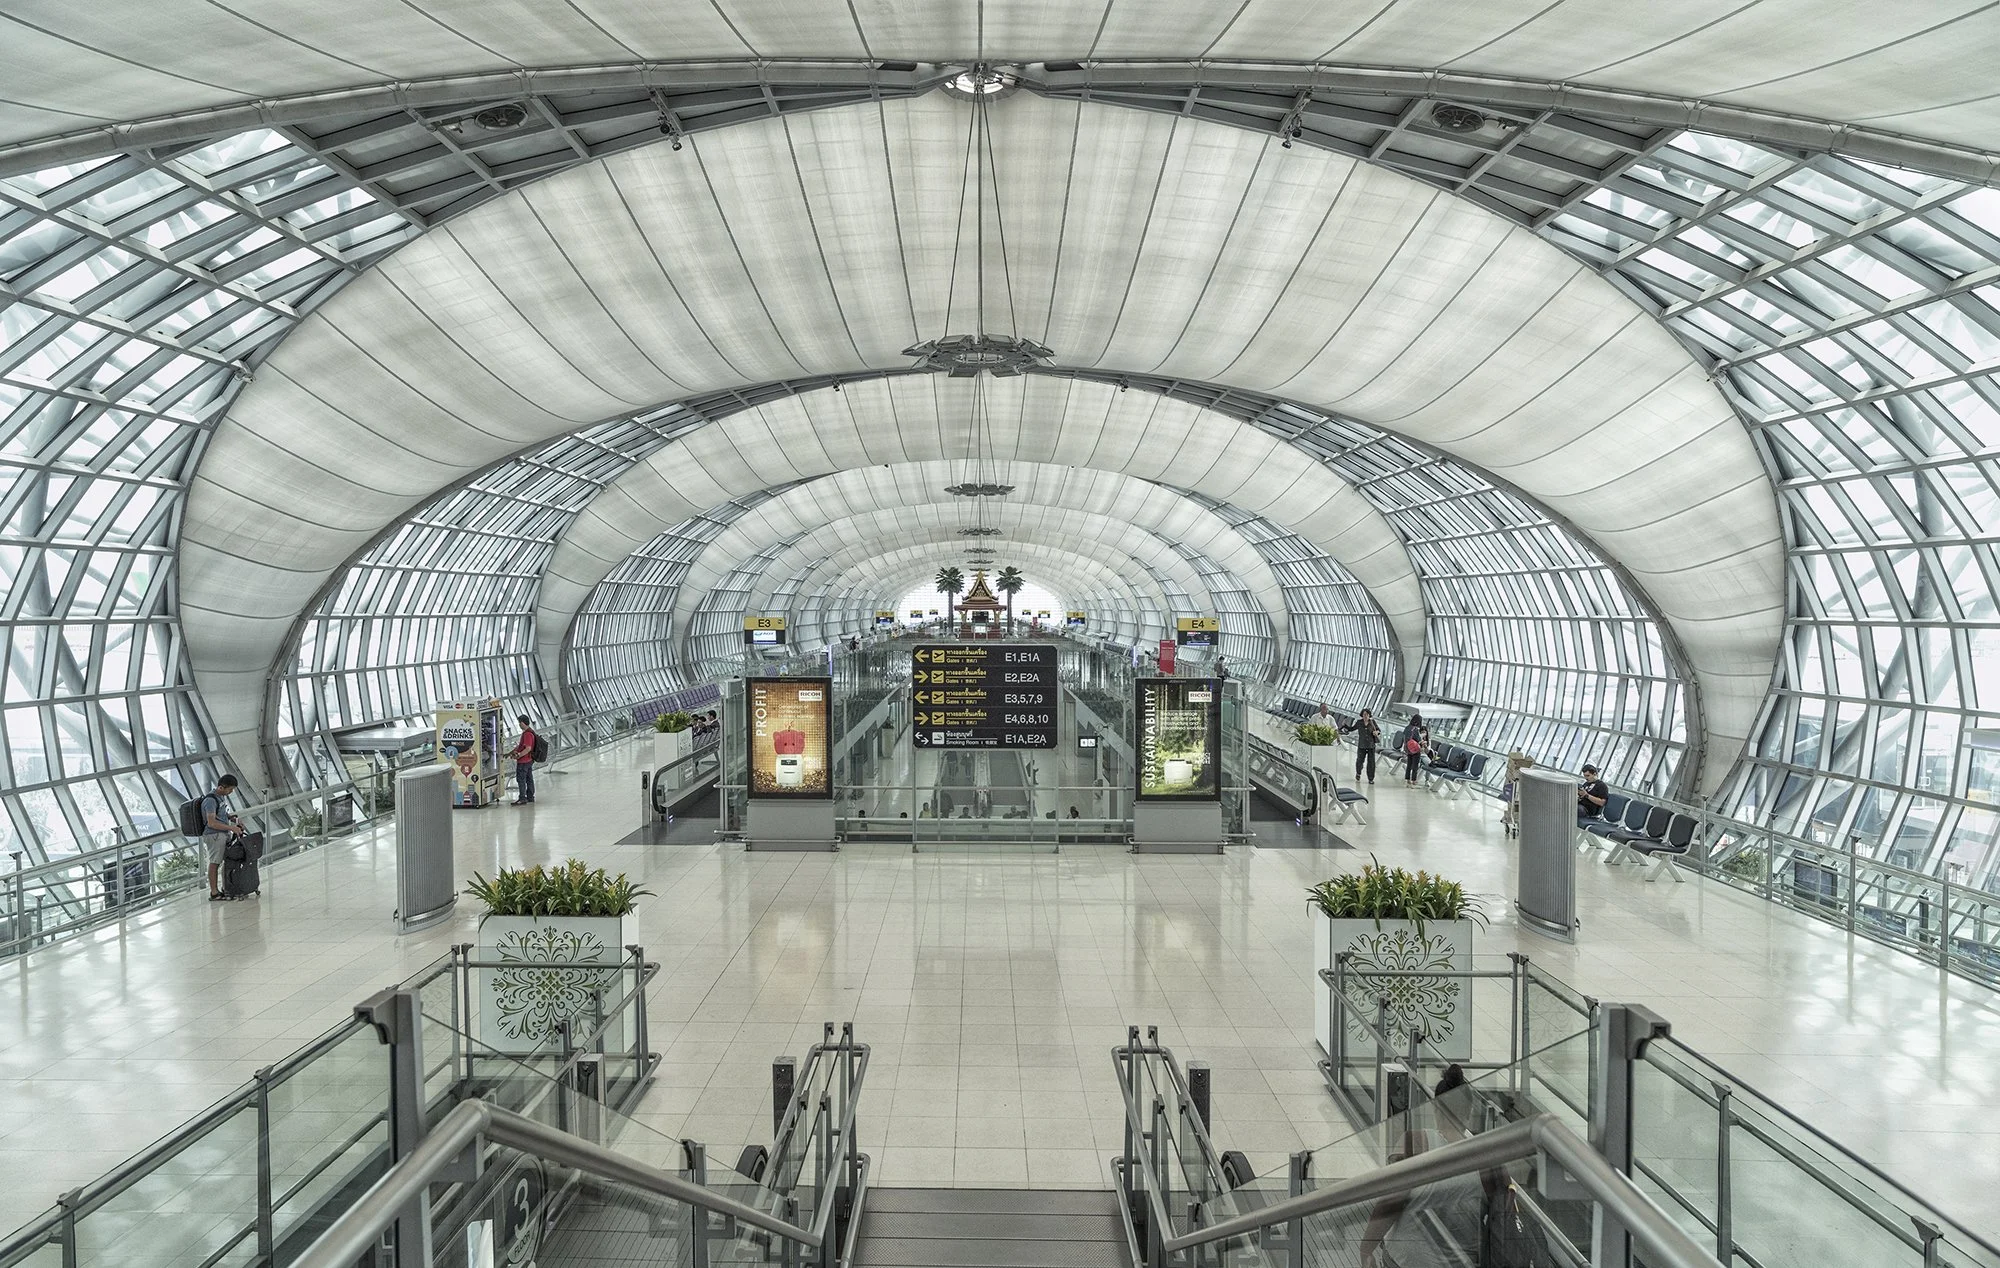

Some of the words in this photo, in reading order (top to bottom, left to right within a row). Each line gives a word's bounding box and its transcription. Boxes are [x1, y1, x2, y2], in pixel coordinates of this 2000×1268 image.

[758, 619, 771, 628] E3
[1191, 620, 1204, 629] E4
[1005, 652, 1040, 663] E1,E1A
[1004, 673, 1040, 684] E2,E2A
[1004, 694, 1043, 704] E3,5,7,9
[755, 688, 767, 737] PROFIT
[1005, 714, 1048, 725] E4,6,8,10
[1005, 734, 1047, 744] E1A,E2A
[1144, 687, 1156, 788] SUSTAINABILITY
[514, 1177, 530, 1240] 3
[513, 1230, 532, 1258] FLOOR
